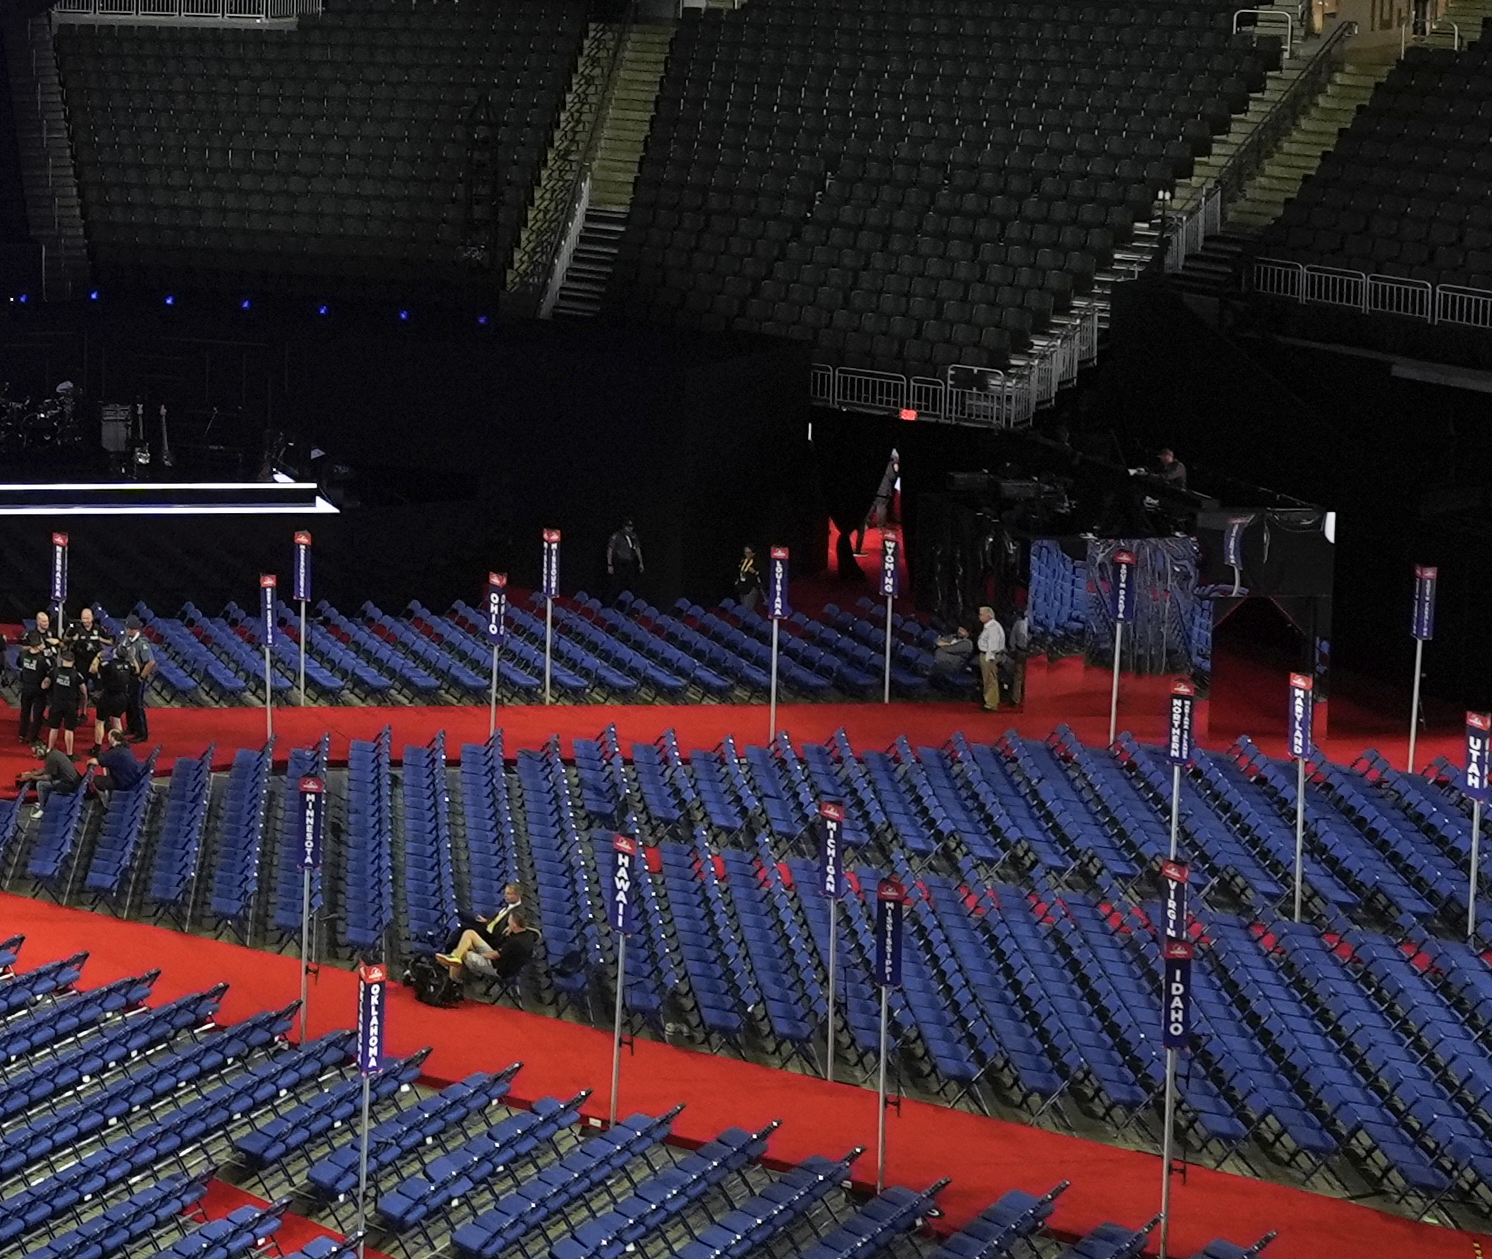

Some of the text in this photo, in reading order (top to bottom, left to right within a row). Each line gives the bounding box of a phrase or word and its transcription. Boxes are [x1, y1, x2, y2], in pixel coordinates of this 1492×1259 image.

[774, 560, 782, 615] LOUISIANA
[884, 541, 896, 593] WYOMING
[489, 592, 499, 634] OHIO
[1170, 698, 1182, 758] NORTHERN
[1294, 689, 1304, 754] MARYLAND
[1467, 736, 1481, 789] UTAH
[304, 793, 315, 864] MINNESOTA
[825, 820, 837, 893] MICHIGAN
[614, 853, 630, 927] HAWAII
[1167, 879, 1178, 938] VIRGIN
[884, 901, 894, 981] MISSISSIPPI
[368, 983, 380, 1068] OKLAHOMA
[1169, 969, 1184, 1036] IDAHO
